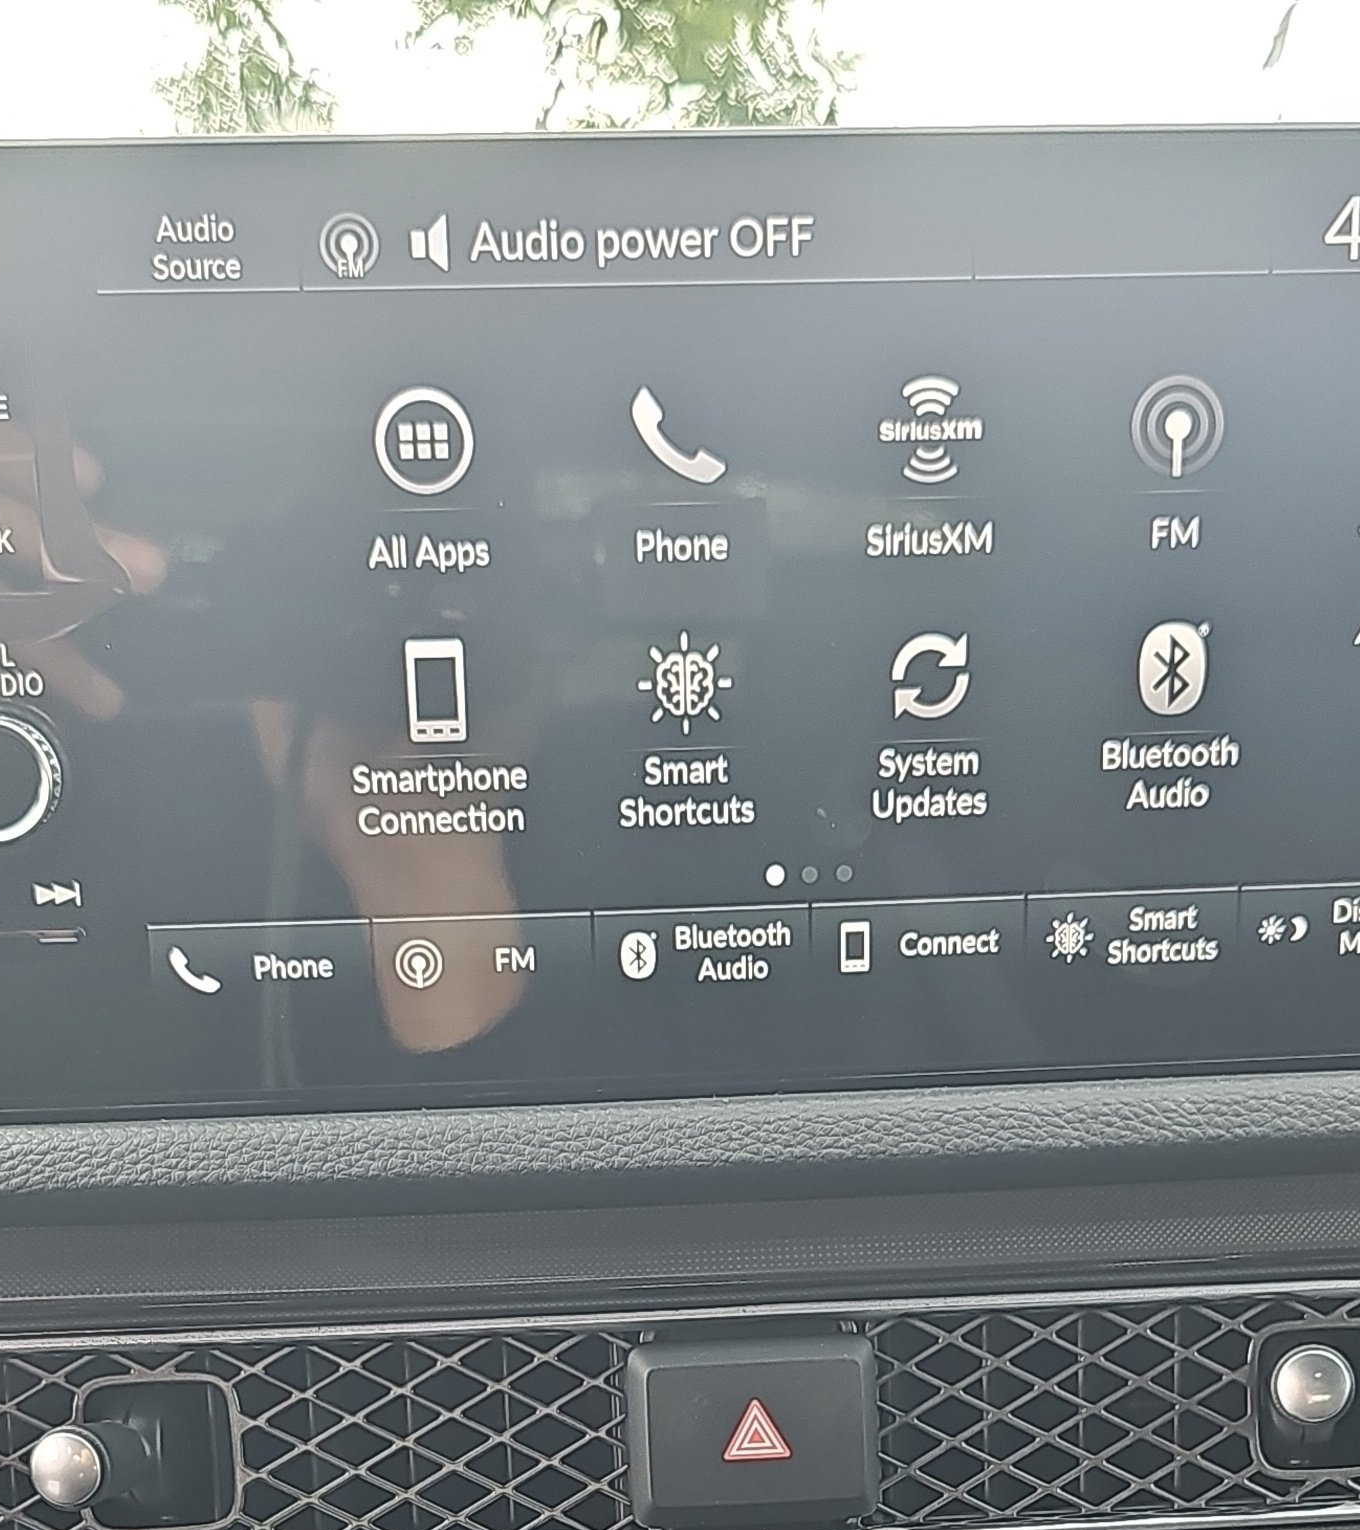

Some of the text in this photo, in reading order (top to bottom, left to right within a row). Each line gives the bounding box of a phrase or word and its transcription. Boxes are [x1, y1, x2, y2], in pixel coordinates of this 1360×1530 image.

[155, 215, 235, 244] Audio
[470, 217, 814, 268] Audio power OFF
[152, 254, 241, 281] Source
[337, 258, 365, 279] FM
[636, 531, 729, 563] Phone
[865, 522, 994, 558] SiriusXM
[1150, 516, 1201, 550] FM
[369, 536, 491, 575] All Apps
[643, 754, 729, 786] Smart
[878, 746, 979, 780] System
[1101, 737, 1239, 772] Bluetooth
[352, 763, 528, 798] Smartphone
[1126, 780, 1209, 811] Audio
[357, 804, 525, 836] Connection
[619, 796, 755, 827] Shortcuts
[872, 787, 988, 825] Updates
[1128, 905, 1198, 933] Smart
[674, 922, 792, 951] Bluetooth
[899, 929, 1000, 958] Connect
[1107, 935, 1219, 965] Shortcuts
[253, 953, 334, 981] Phone
[494, 946, 536, 973] FM
[697, 955, 770, 982] Audio
